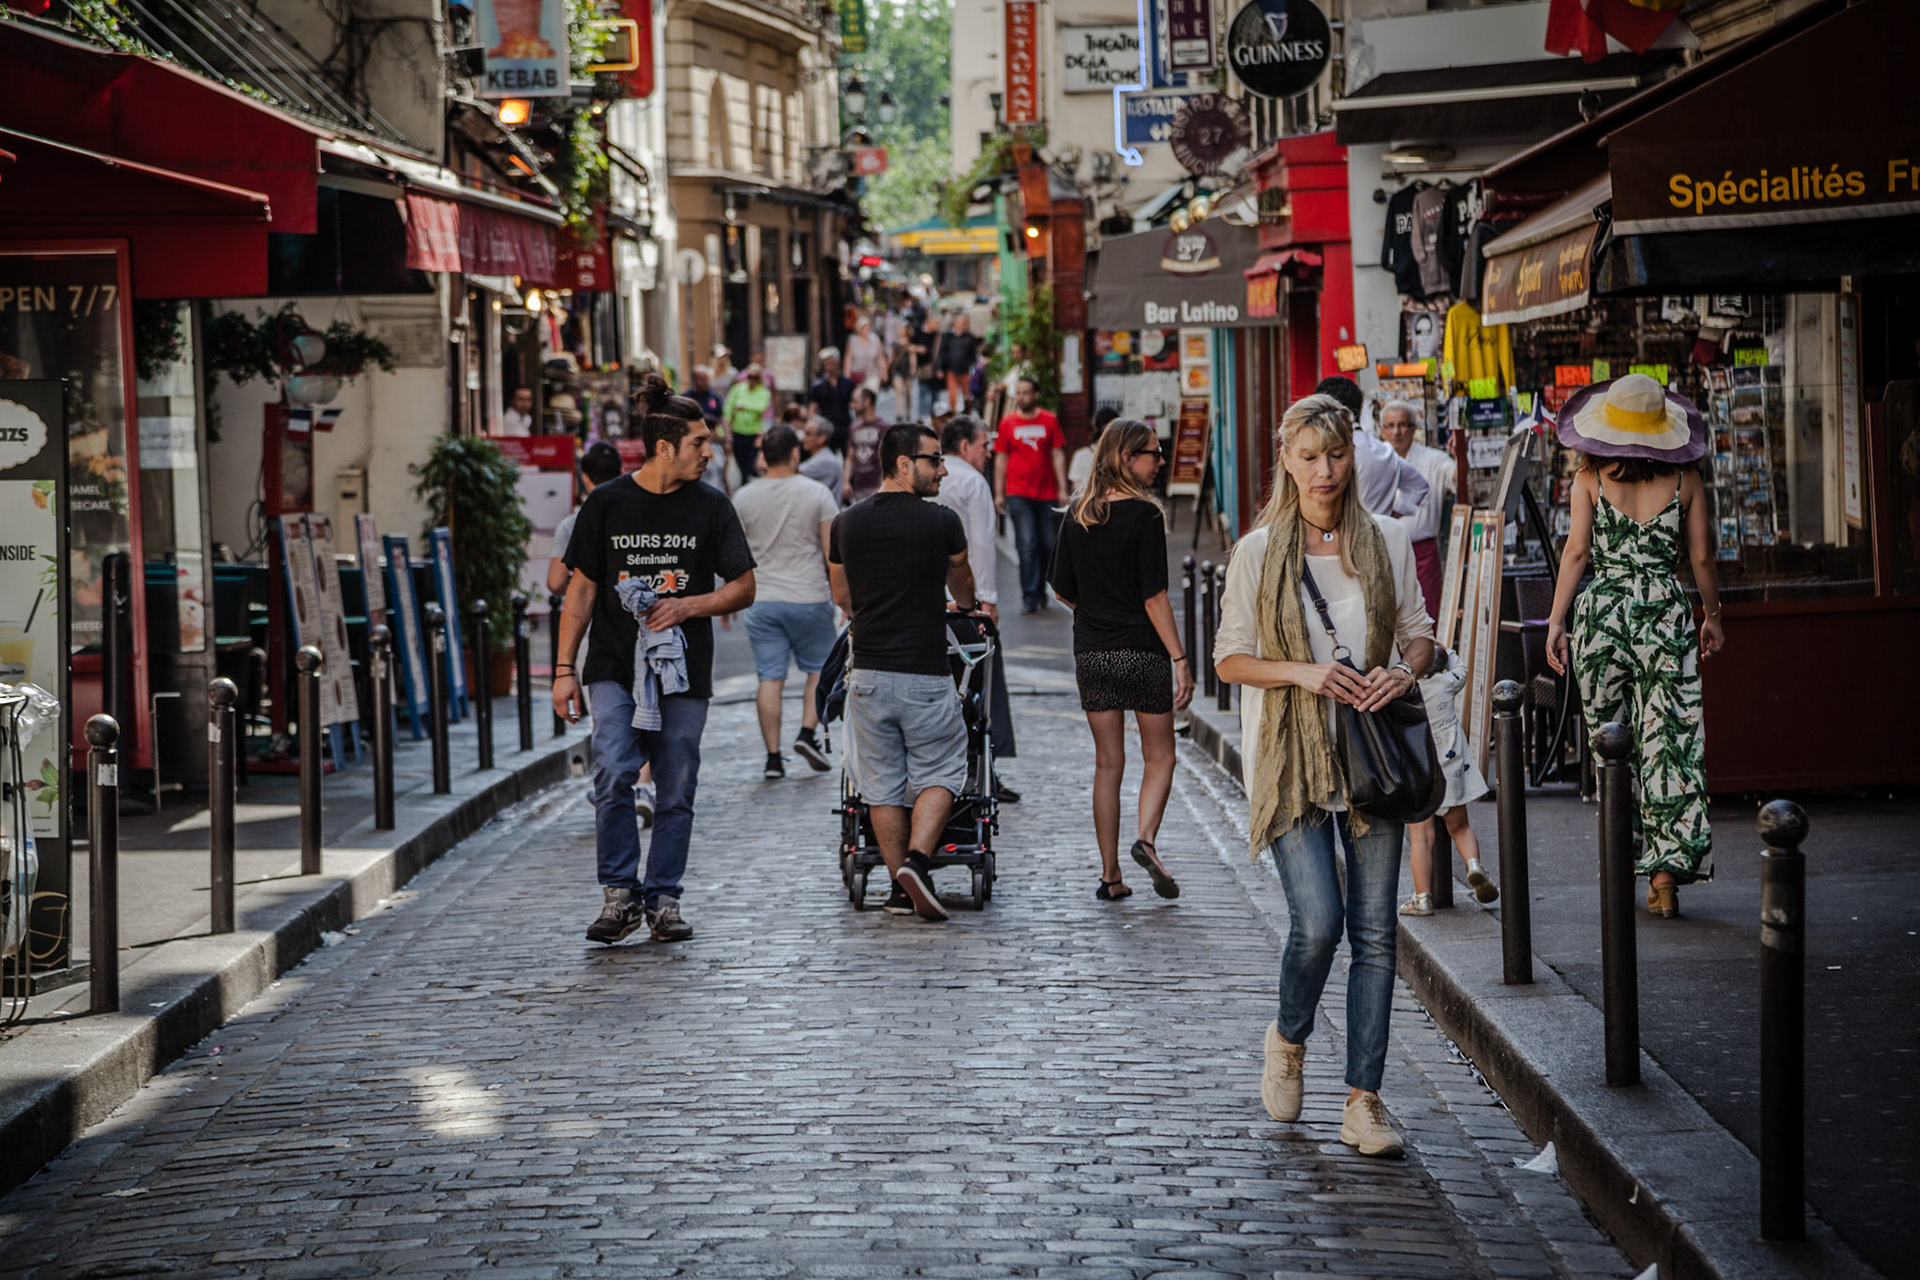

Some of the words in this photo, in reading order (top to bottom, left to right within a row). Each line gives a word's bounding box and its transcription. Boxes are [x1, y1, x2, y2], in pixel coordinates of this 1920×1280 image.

[1012, 3, 1031, 121] RESTAURANT
[1234, 41, 1325, 66] GUINNESS
[487, 68, 559, 90] KEBAB
[1199, 127, 1223, 145] 27
[1669, 163, 1866, 215] Spécialités
[1176, 245, 1206, 264] 27
[0, 285, 56, 311] PEN
[67, 285, 117, 316] 7/7
[1144, 301, 1178, 324] Bar
[1180, 300, 1239, 324] Latino
[0, 545, 36, 561] NSIDE
[611, 534, 661, 550] TOURS
[663, 534, 696, 550] 2014
[626, 553, 678, 565] Séminaire
